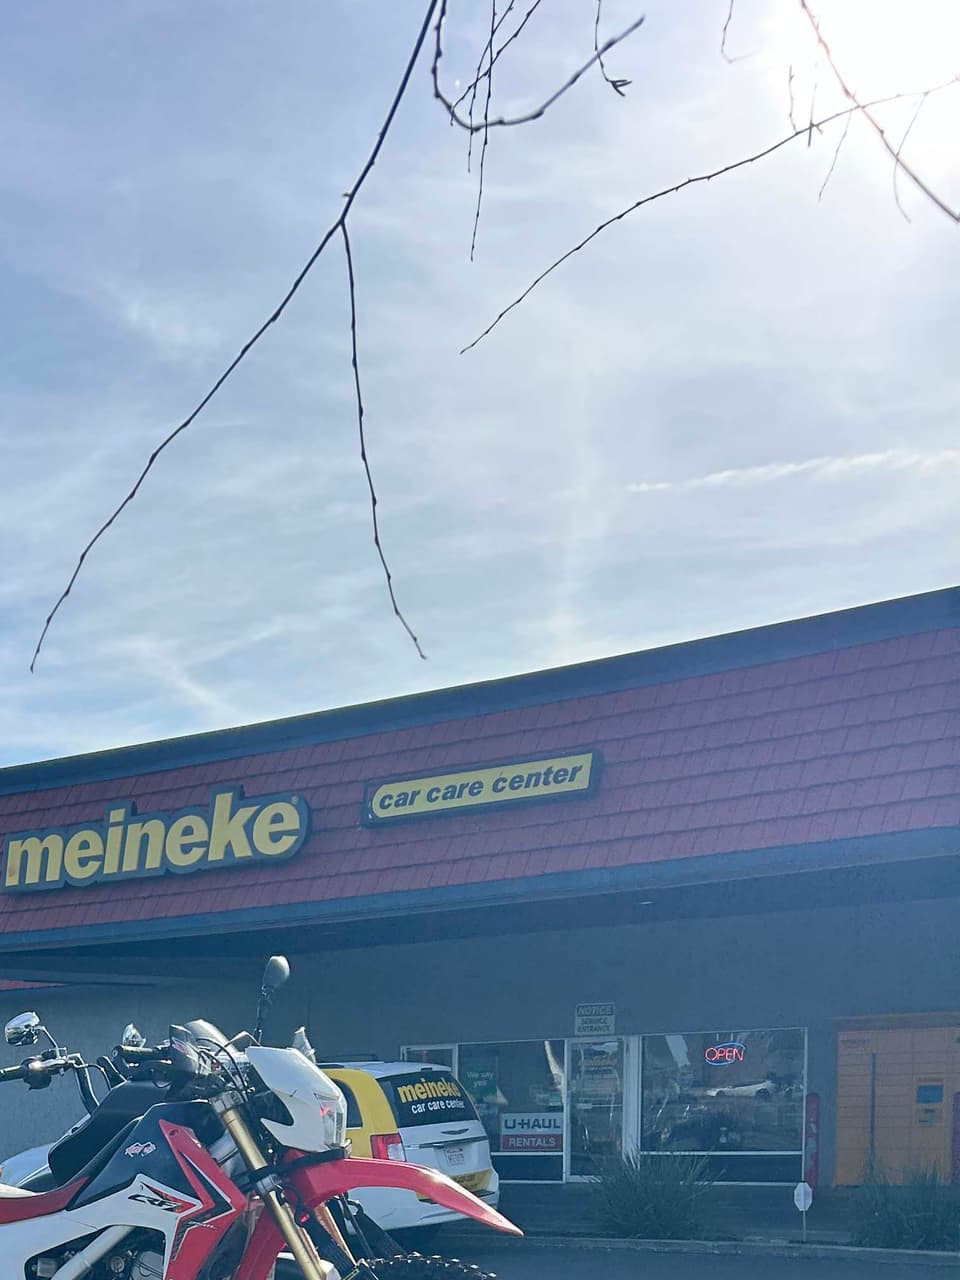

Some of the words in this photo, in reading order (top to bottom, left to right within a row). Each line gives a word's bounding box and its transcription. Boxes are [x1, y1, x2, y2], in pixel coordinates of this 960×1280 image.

[379, 789, 421, 810] car
[426, 780, 484, 803] care
[492, 763, 583, 793] center
[5, 792, 300, 887] meineke
[705, 1047, 744, 1061] OPEN
[397, 1077, 461, 1103] meineke
[411, 1103, 426, 1114] car
[428, 1100, 445, 1111] care
[508, 1137, 556, 1147] RENTALS
